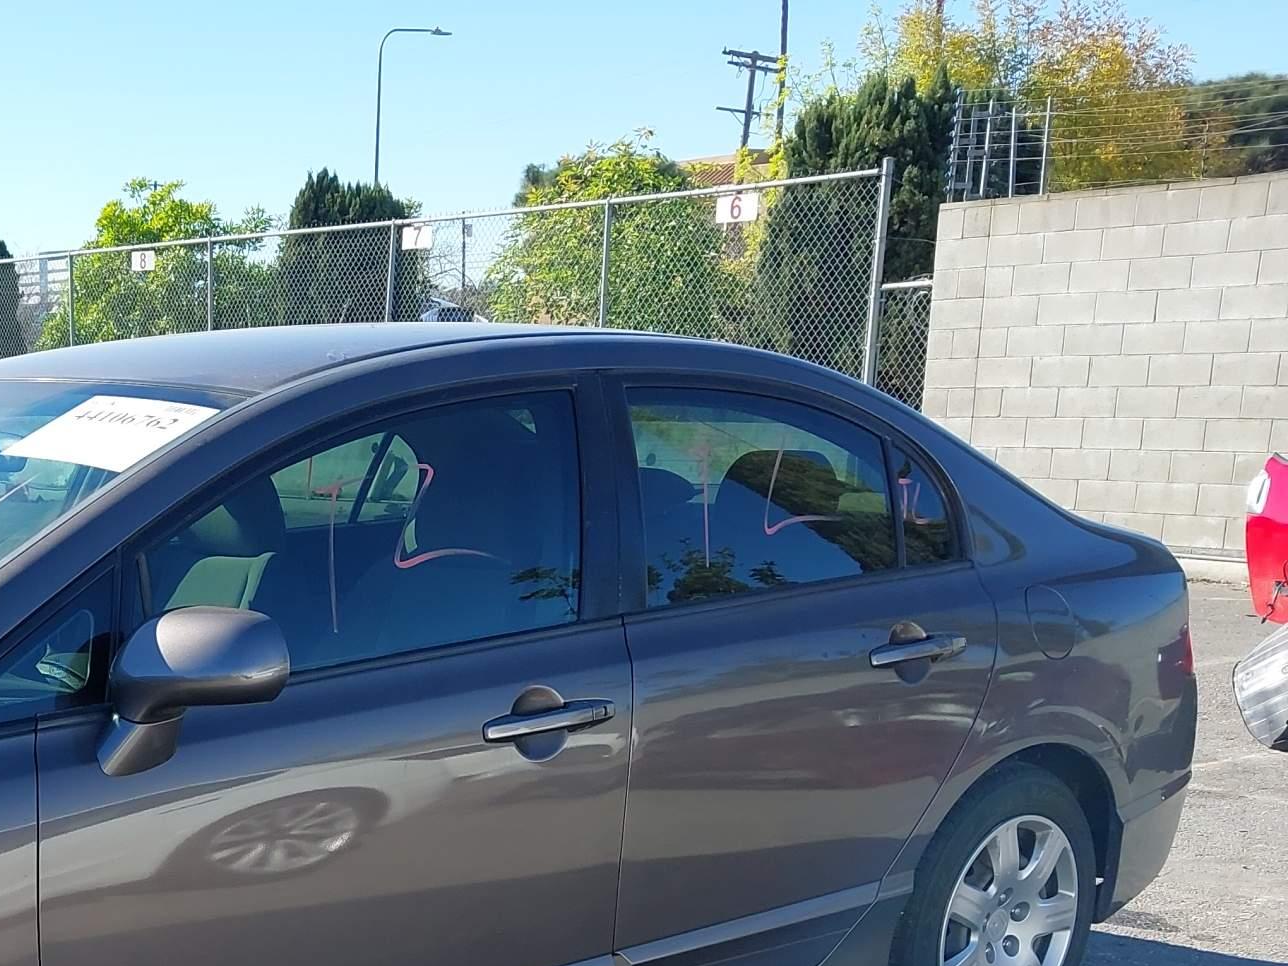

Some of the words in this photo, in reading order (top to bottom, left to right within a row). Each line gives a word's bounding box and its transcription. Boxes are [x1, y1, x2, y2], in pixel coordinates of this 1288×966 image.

[729, 195, 743, 220] 6
[413, 225, 423, 247] 7
[138, 252, 148, 270] 8
[74, 409, 180, 430] 44106762
